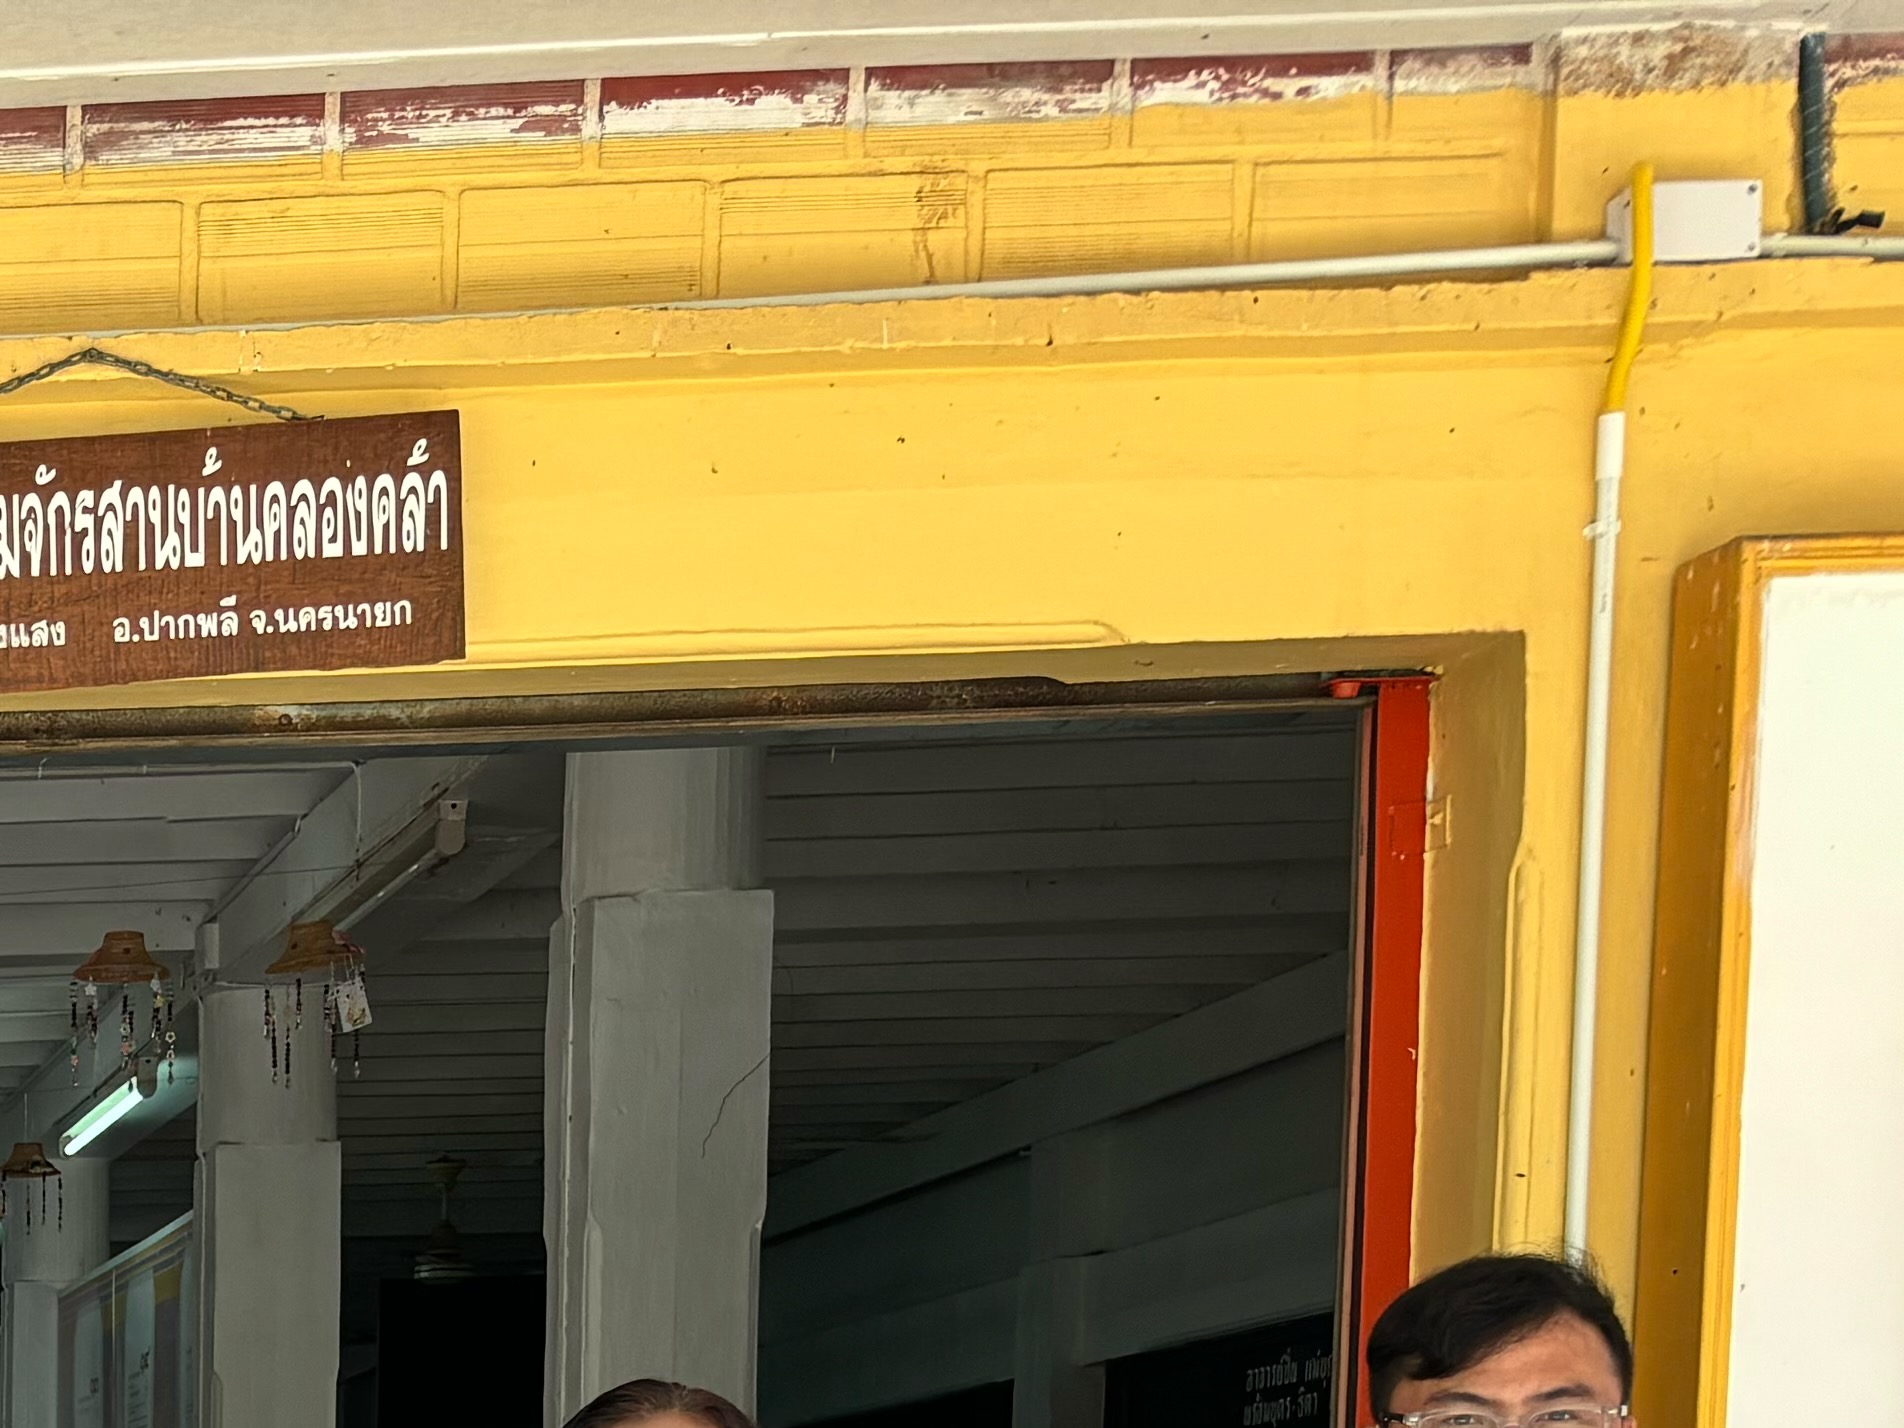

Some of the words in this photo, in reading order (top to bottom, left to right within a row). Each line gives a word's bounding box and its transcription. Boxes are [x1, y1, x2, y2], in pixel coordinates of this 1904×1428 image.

[112, 595, 240, 644] อ.ปากพลี
[249, 598, 412, 635] จ.นครนายก
